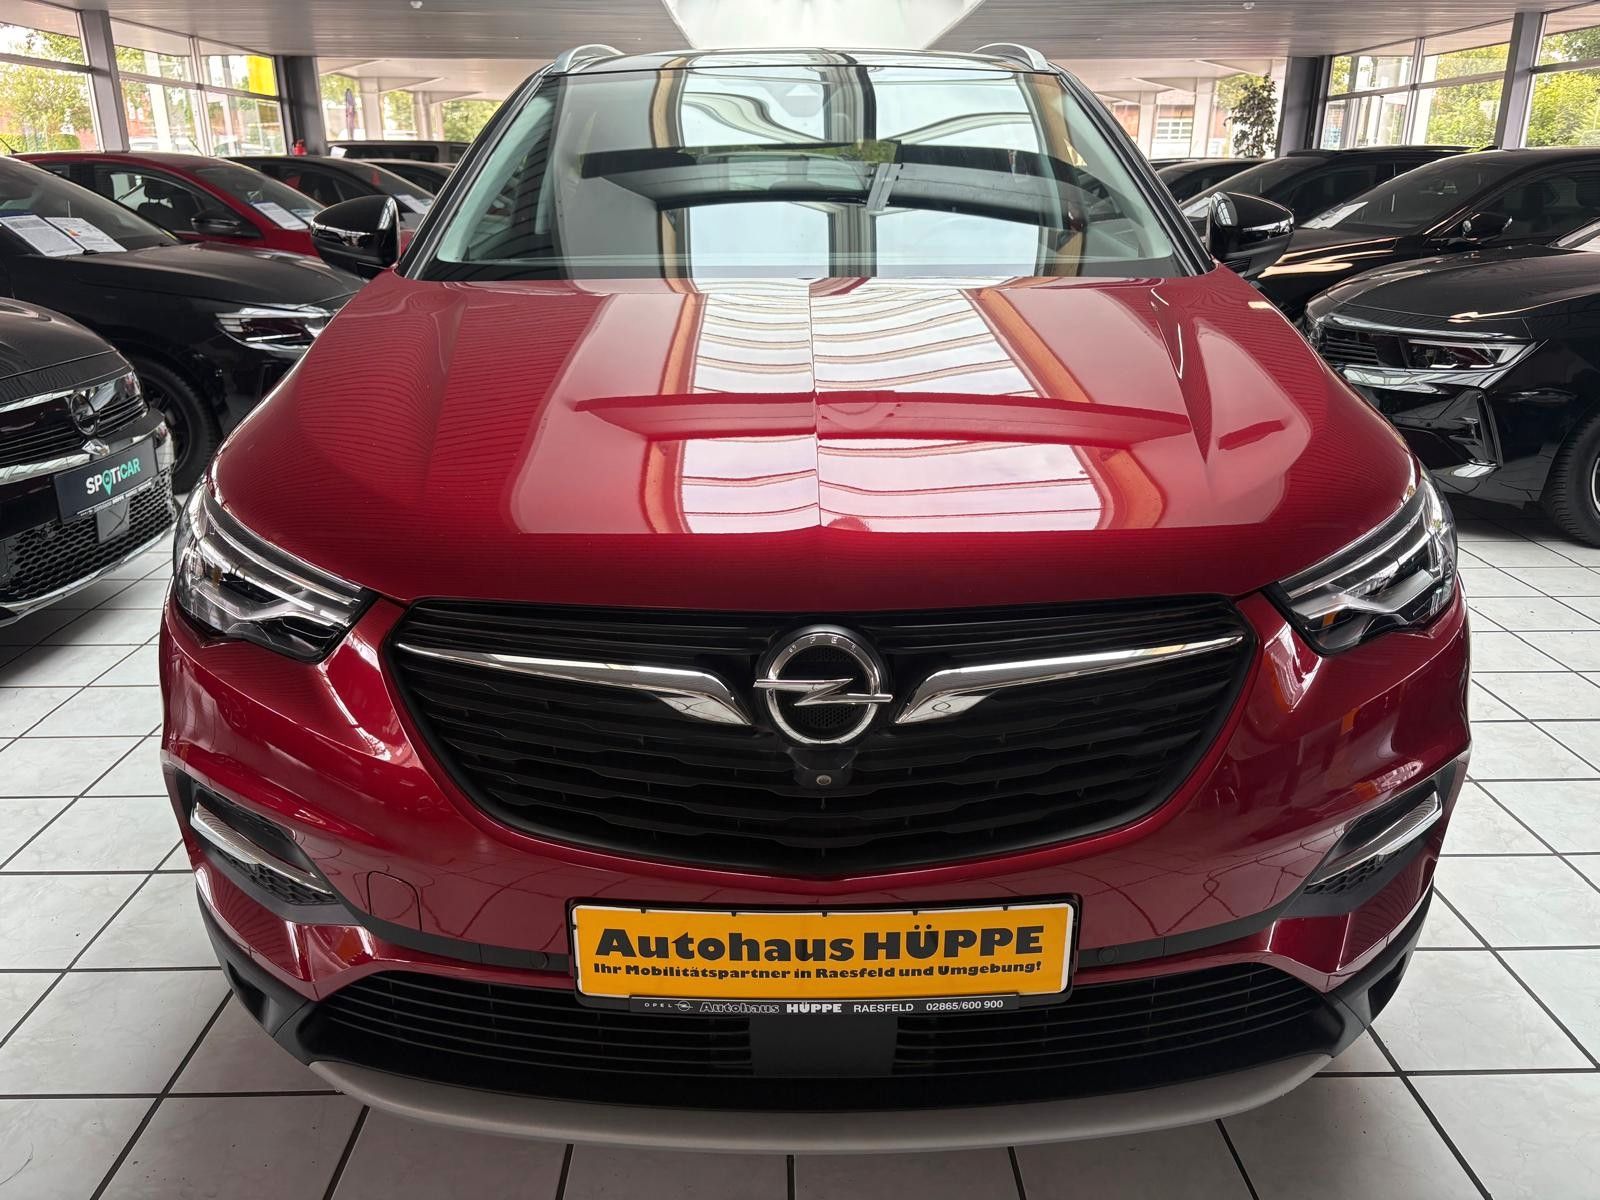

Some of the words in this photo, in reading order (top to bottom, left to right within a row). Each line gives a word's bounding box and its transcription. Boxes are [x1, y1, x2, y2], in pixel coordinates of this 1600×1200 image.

[595, 928, 854, 962] Autohaus
[863, 924, 1044, 960] HÜPPE
[594, 963, 622, 974] Ihr
[625, 965, 791, 980] Mobilitätspartner
[794, 968, 811, 979] in
[815, 966, 895, 979] Raesfeld
[899, 966, 934, 977] und
[937, 961, 1042, 976] Umgebung!
[699, 1002, 780, 1014] Autohaus
[786, 1001, 842, 1014] HÜPPE
[853, 1003, 914, 1013] RAESFELD
[926, 1001, 981, 1011] 02865/600
[983, 1000, 1004, 1009] 900
